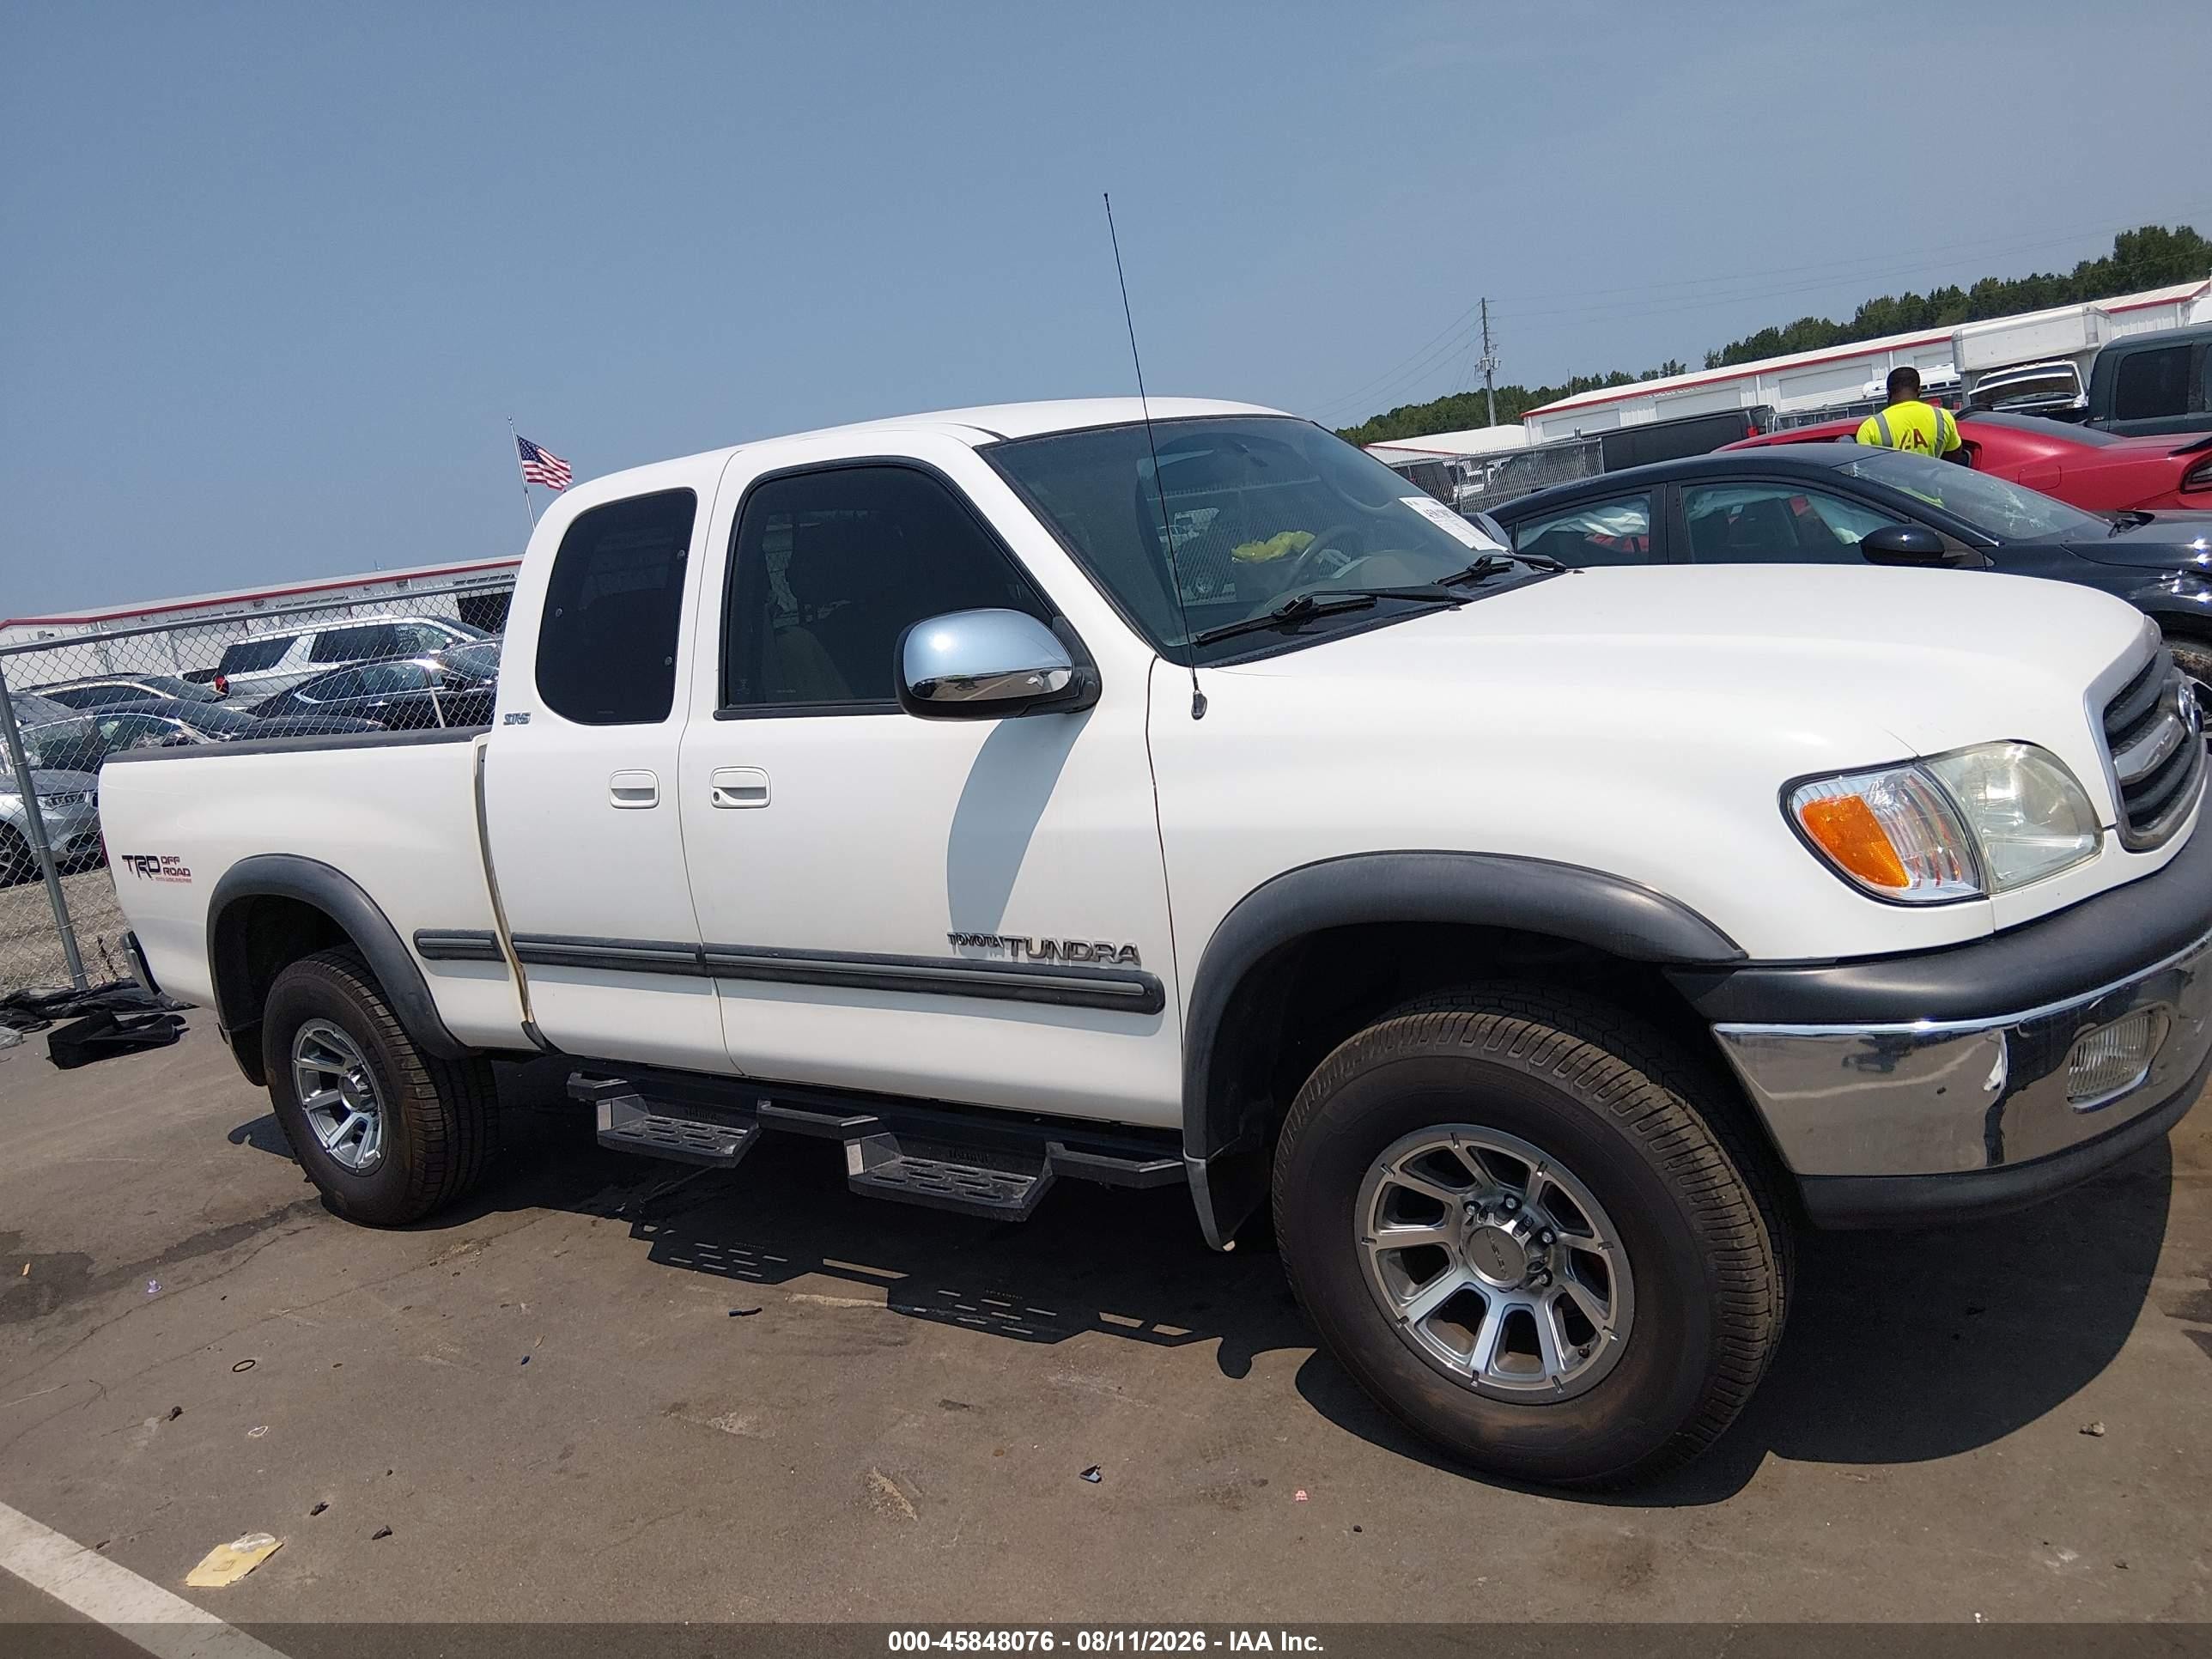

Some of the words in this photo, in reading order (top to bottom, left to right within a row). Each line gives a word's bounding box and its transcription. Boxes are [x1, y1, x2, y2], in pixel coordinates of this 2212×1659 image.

[121, 854, 161, 879] TRD
[160, 856, 180, 866] OFF
[162, 866, 191, 877] ROAD
[946, 933, 1005, 948] TOYOTA
[1003, 934, 1141, 965] TUNDRA
